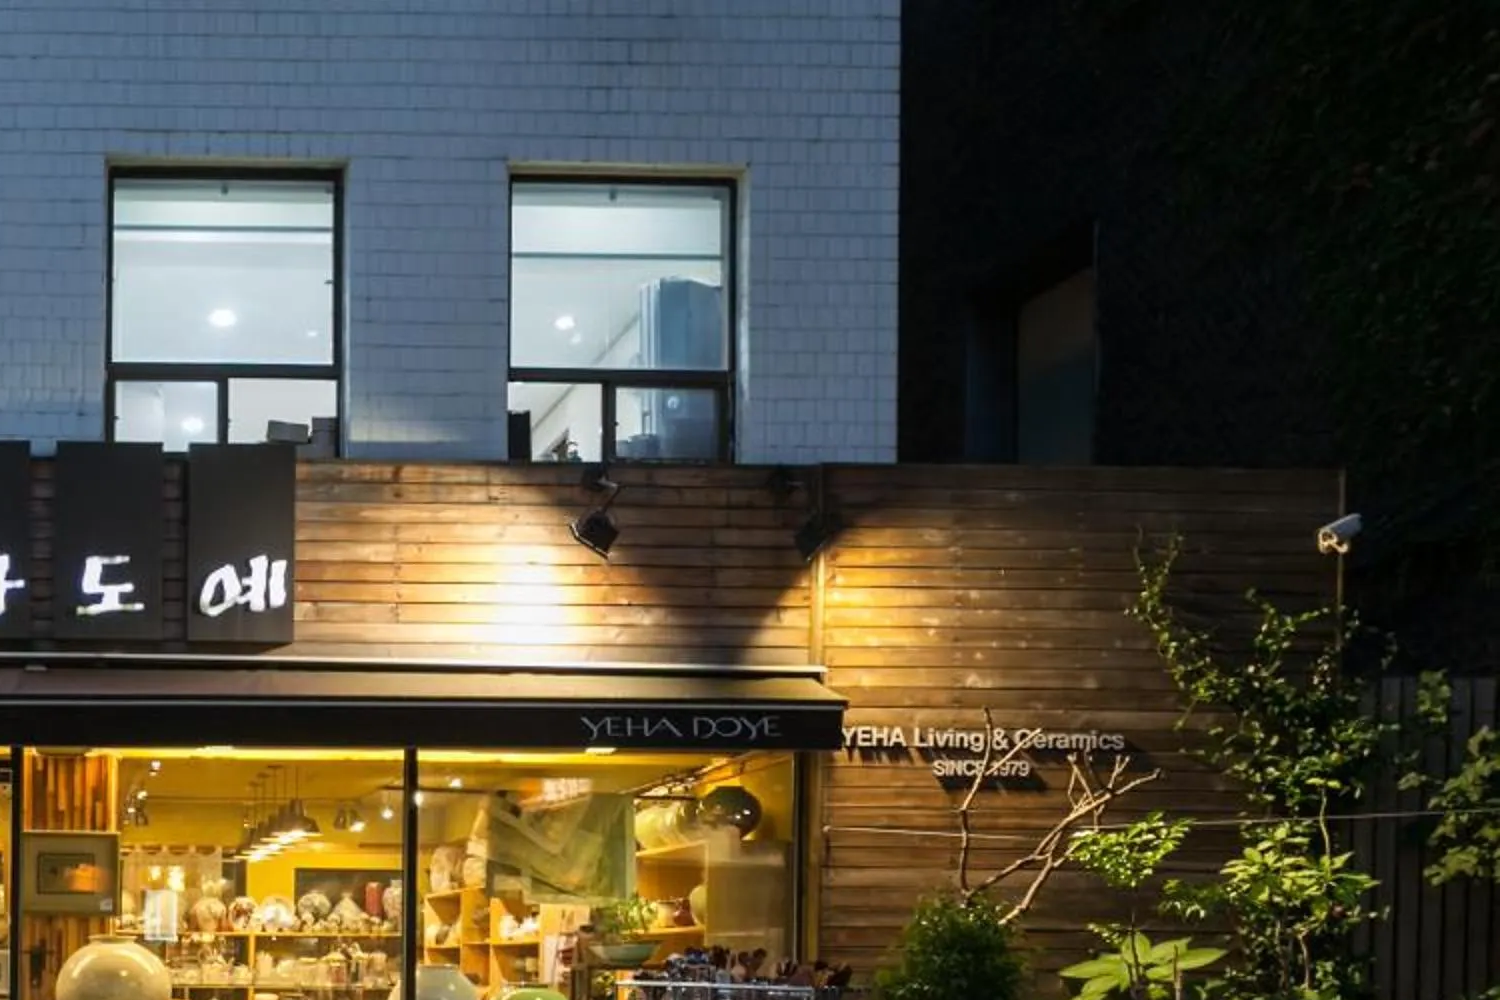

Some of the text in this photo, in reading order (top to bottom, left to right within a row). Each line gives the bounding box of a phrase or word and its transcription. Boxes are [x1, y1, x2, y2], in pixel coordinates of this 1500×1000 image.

[581, 716, 782, 740] YEHA DOYE
[841, 727, 1125, 751] YEHA Living & Ceramics
